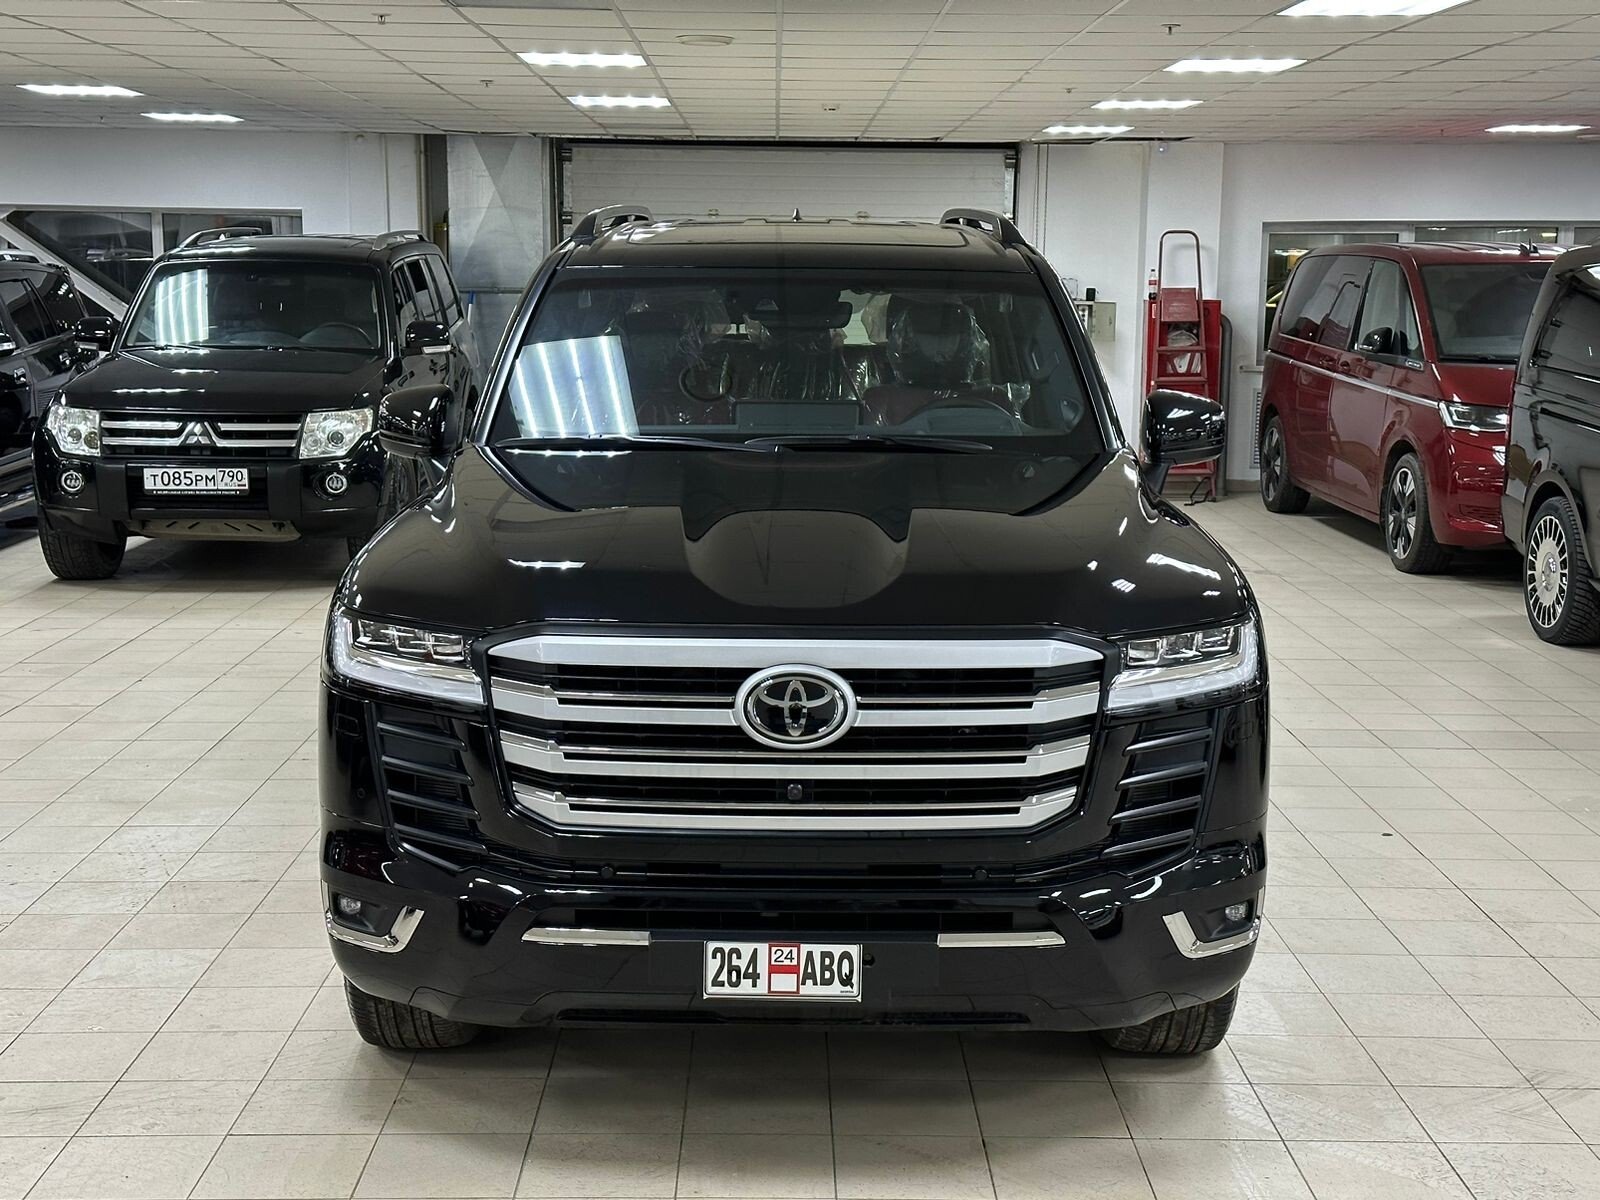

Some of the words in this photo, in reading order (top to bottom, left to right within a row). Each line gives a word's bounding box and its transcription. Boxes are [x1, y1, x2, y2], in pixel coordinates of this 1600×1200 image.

[218, 470, 244, 482] 790
[711, 947, 760, 988] 264
[773, 948, 795, 963] 24
[800, 950, 855, 990] ABQ
